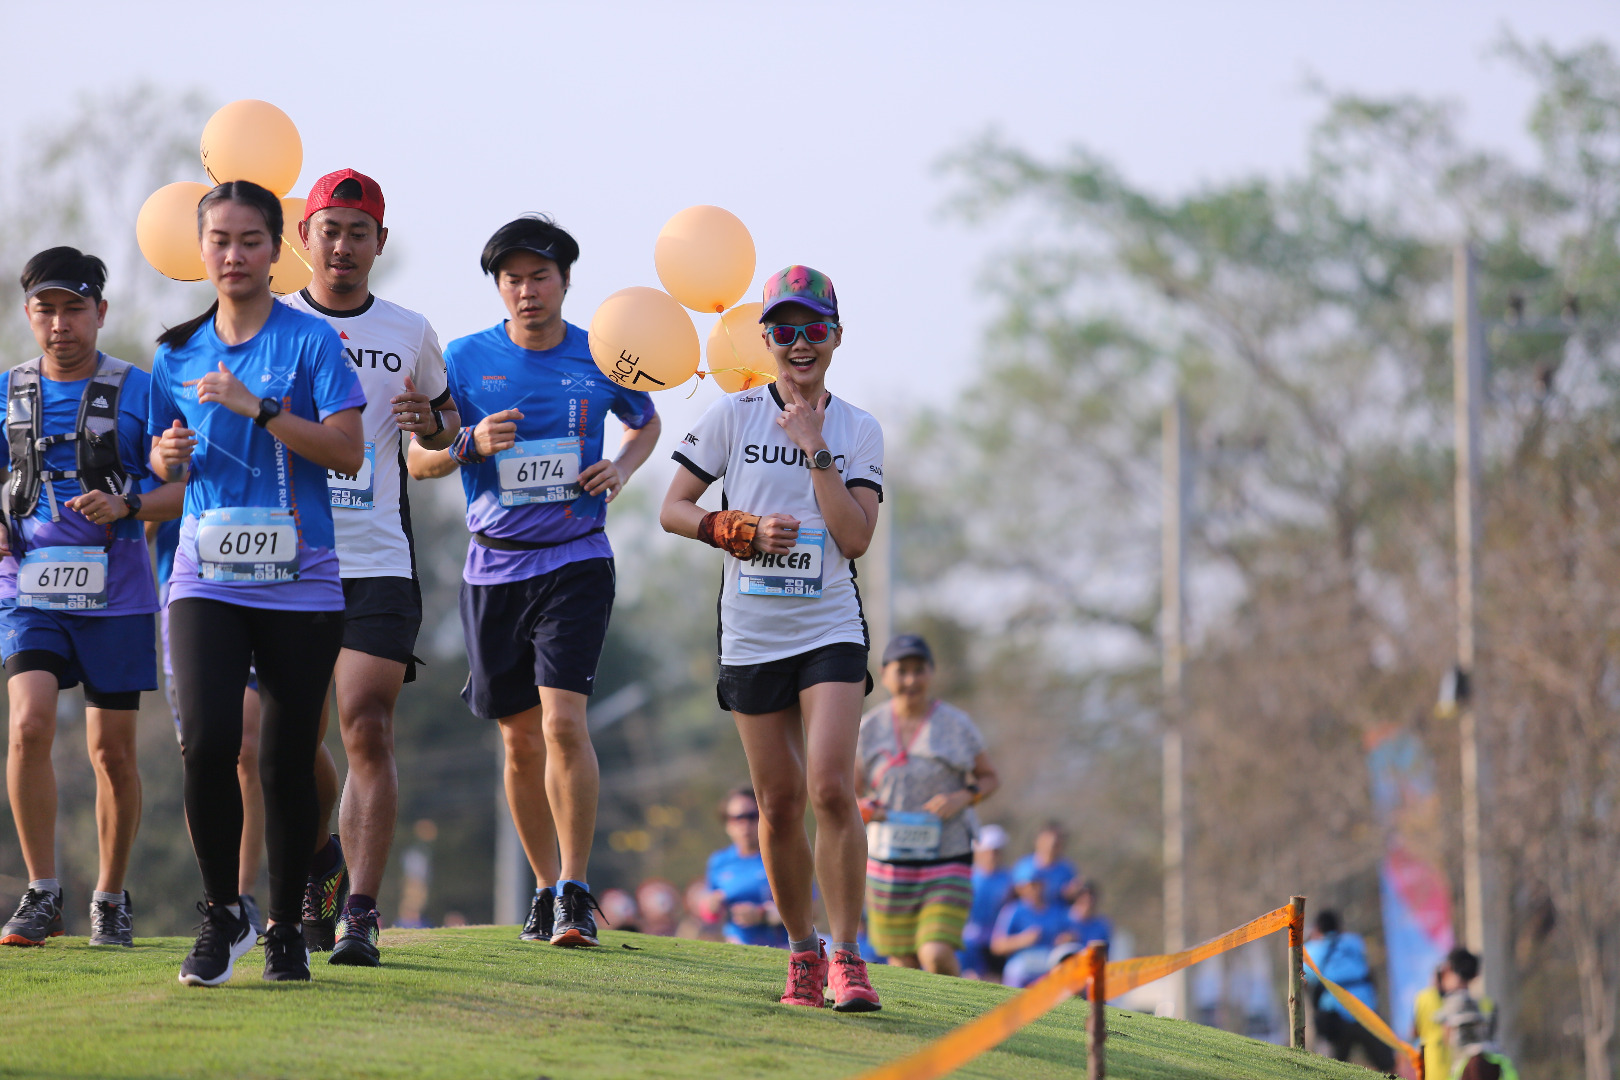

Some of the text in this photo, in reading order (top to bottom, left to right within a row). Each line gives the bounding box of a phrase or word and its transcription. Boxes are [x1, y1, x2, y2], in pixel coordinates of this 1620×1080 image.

[346, 348, 402, 373] NTO
[608, 349, 640, 386] PACE
[632, 370, 666, 386] 7
[568, 399, 577, 428] CROSS
[579, 399, 588, 436] SINGHA
[517, 459, 564, 482] 6174
[744, 444, 845, 474] SUUO
[219, 532, 278, 555] 6091
[750, 551, 812, 570] PACER
[38, 567, 89, 587] 6170
